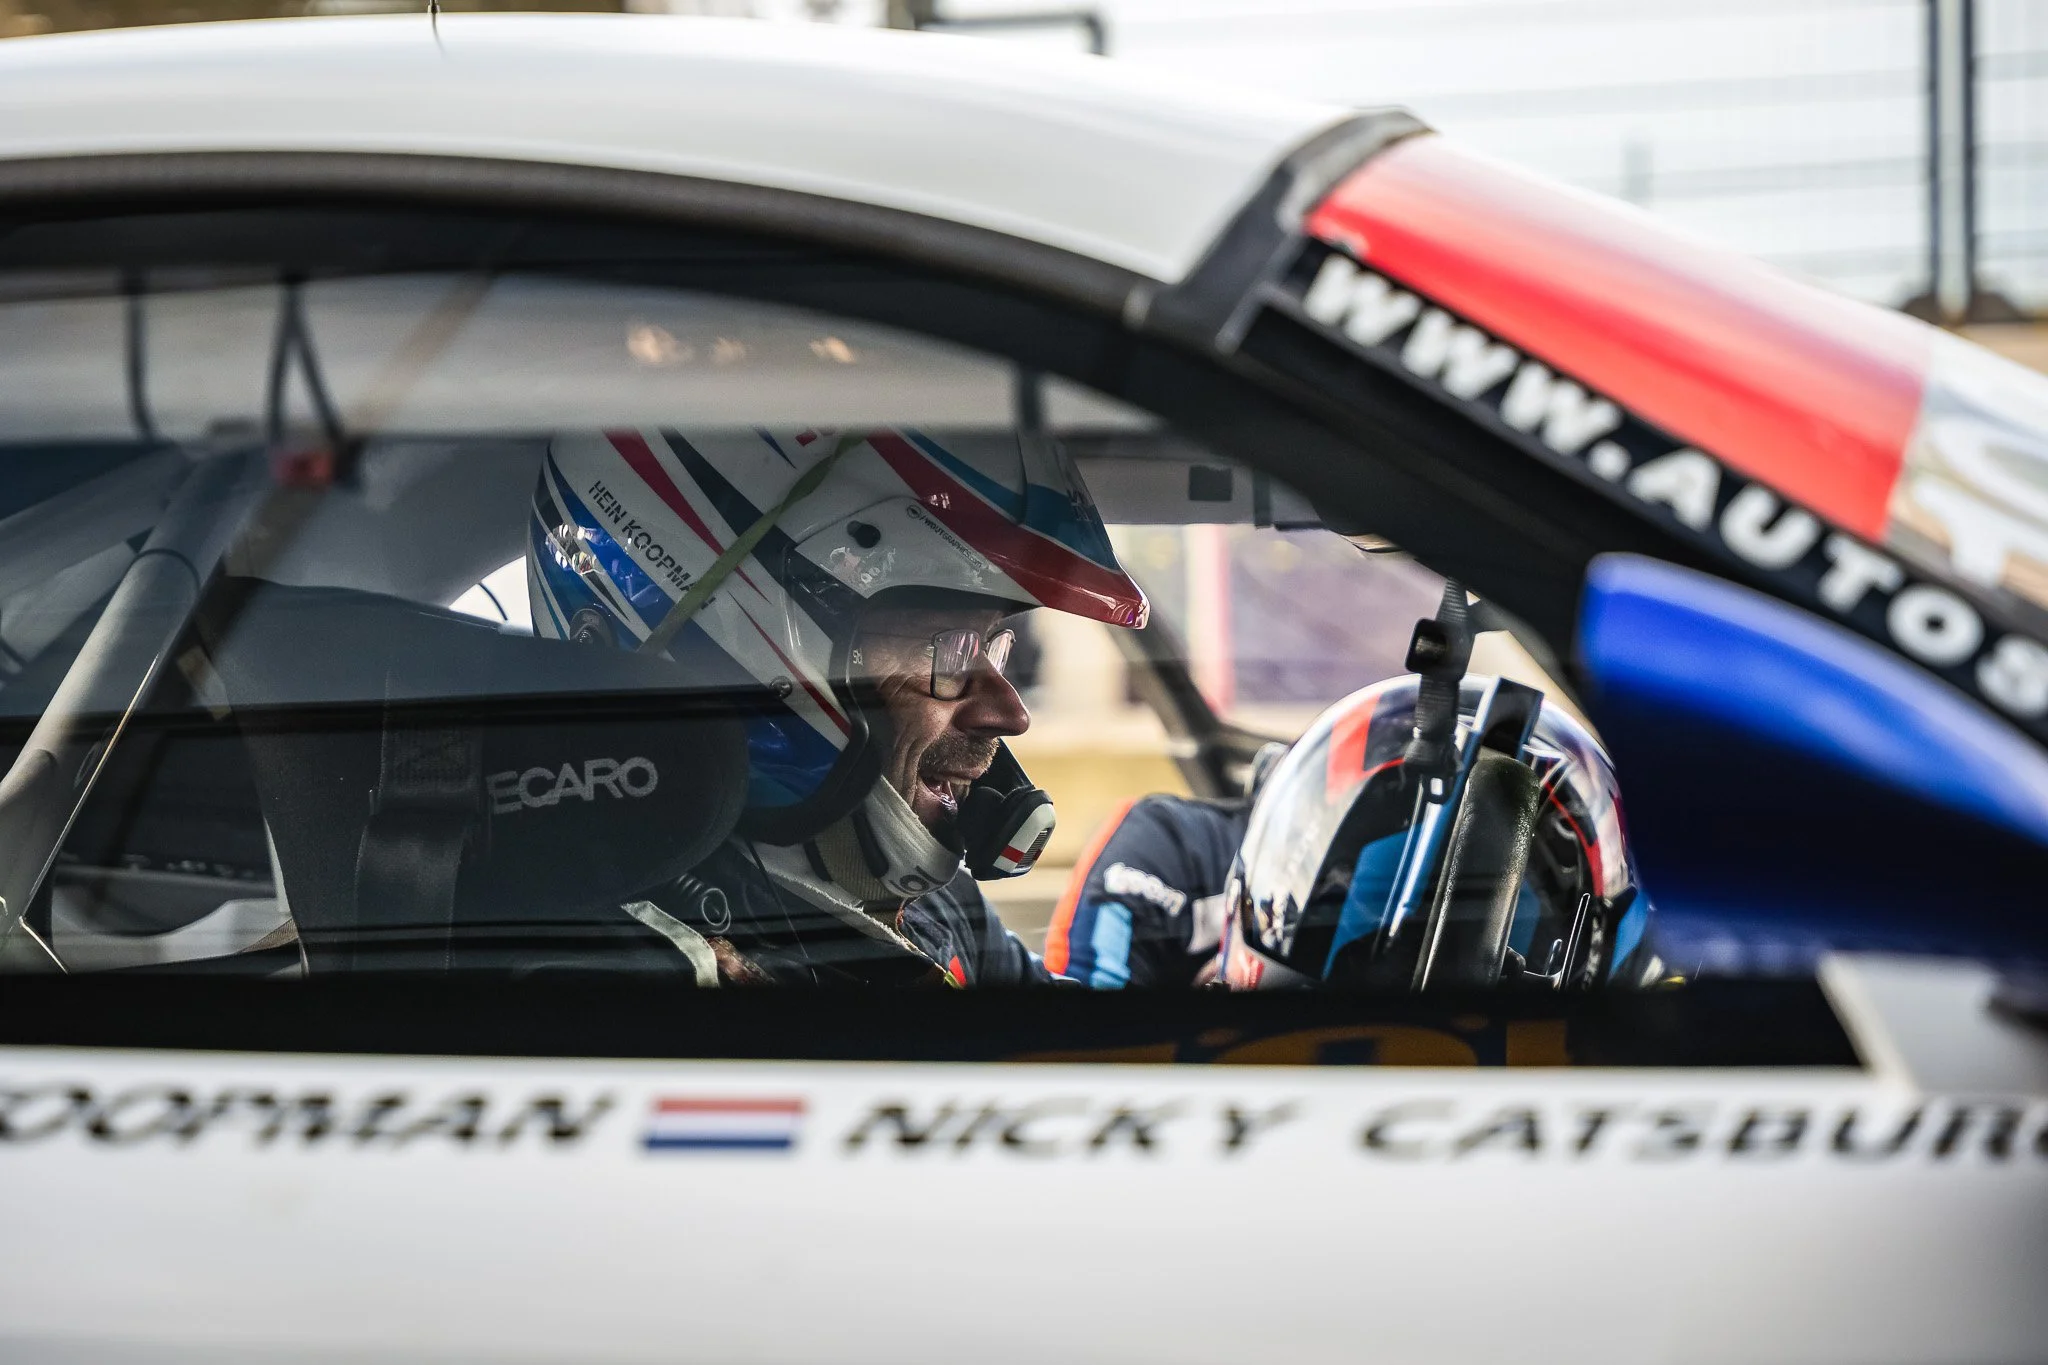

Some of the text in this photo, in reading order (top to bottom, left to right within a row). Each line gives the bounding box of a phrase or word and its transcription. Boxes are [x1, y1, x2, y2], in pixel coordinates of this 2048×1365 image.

[588, 480, 627, 525] HEIN
[485, 756, 659, 815] ECARO
[838, 1096, 2048, 1161] NICKY CATSBUR
